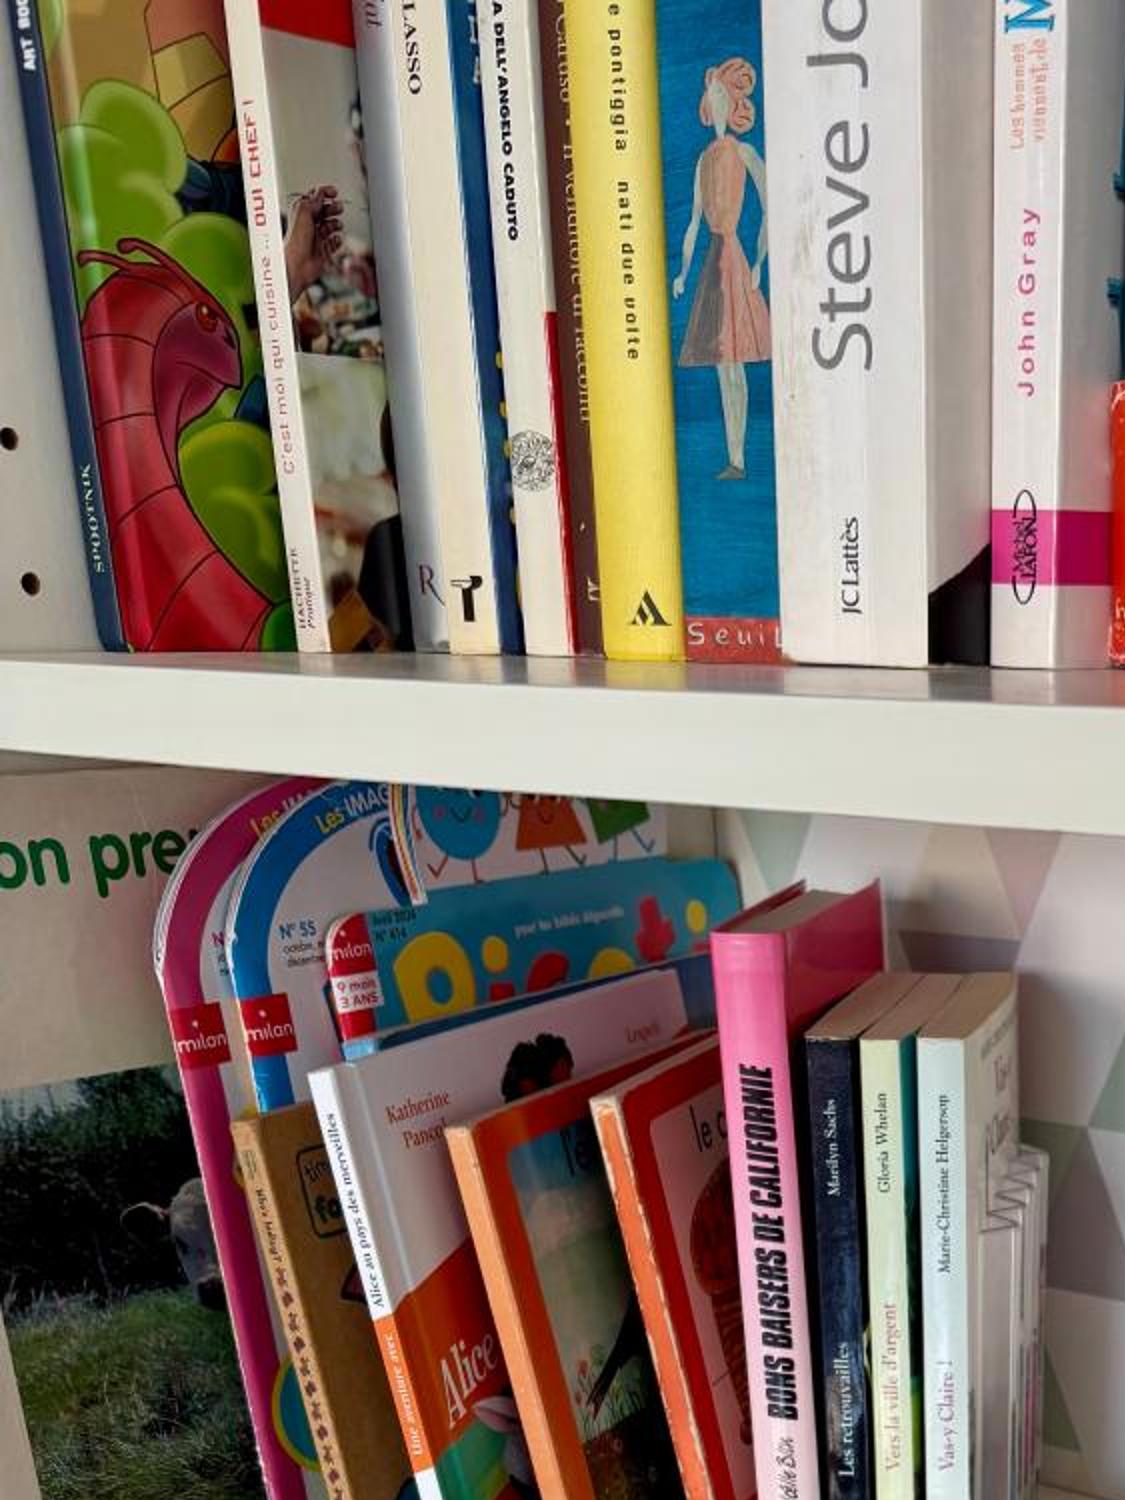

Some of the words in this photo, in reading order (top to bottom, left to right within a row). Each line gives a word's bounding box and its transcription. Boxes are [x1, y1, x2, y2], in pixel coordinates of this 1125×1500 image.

[22, 37, 37, 71] ART
[608, 29, 629, 151] pontiggia
[244, 113, 264, 180] CHEF
[493, 23, 513, 156] DELL'ANGELO
[503, 163, 519, 241] CADUTO
[252, 187, 267, 227] OUI
[617, 181, 634, 230] nati
[621, 243, 635, 285] due
[811, 121, 874, 371] Steve
[1017, 208, 1041, 296] Gray
[263, 254, 281, 331] cuisine
[624, 298, 641, 360] volte
[272, 343, 286, 377] qui
[1017, 310, 1036, 398] John
[279, 385, 290, 420] moi
[299, 920, 317, 937] 55
[332, 930, 371, 960] milan
[174, 1022, 228, 1056] milan
[247, 1010, 295, 1043] milan
[386, 1092, 450, 1125] Katherine
[823, 1098, 840, 1139] Sachs
[873, 1092, 890, 1147] Whelan
[738, 1063, 783, 1208] CALIFORNIE
[825, 1142, 843, 1197] Marilyn
[874, 1150, 892, 1194] Gloria
[751, 1212, 786, 1243] DE
[935, 1168, 952, 1273] Marie-Christine
[757, 1249, 795, 1350] BAISERS
[880, 1303, 903, 1373] d'argent
[439, 1334, 497, 1430] Alice
[763, 1357, 799, 1421] BONS
[832, 1341, 854, 1444] retrouvailles
[881, 1378, 900, 1412] ville
[935, 1372, 955, 1422] Claire
[882, 1416, 902, 1431] la
[838, 1448, 856, 1478] Les
[882, 1434, 902, 1472] Vers
[937, 1426, 959, 1472] Vas-y
